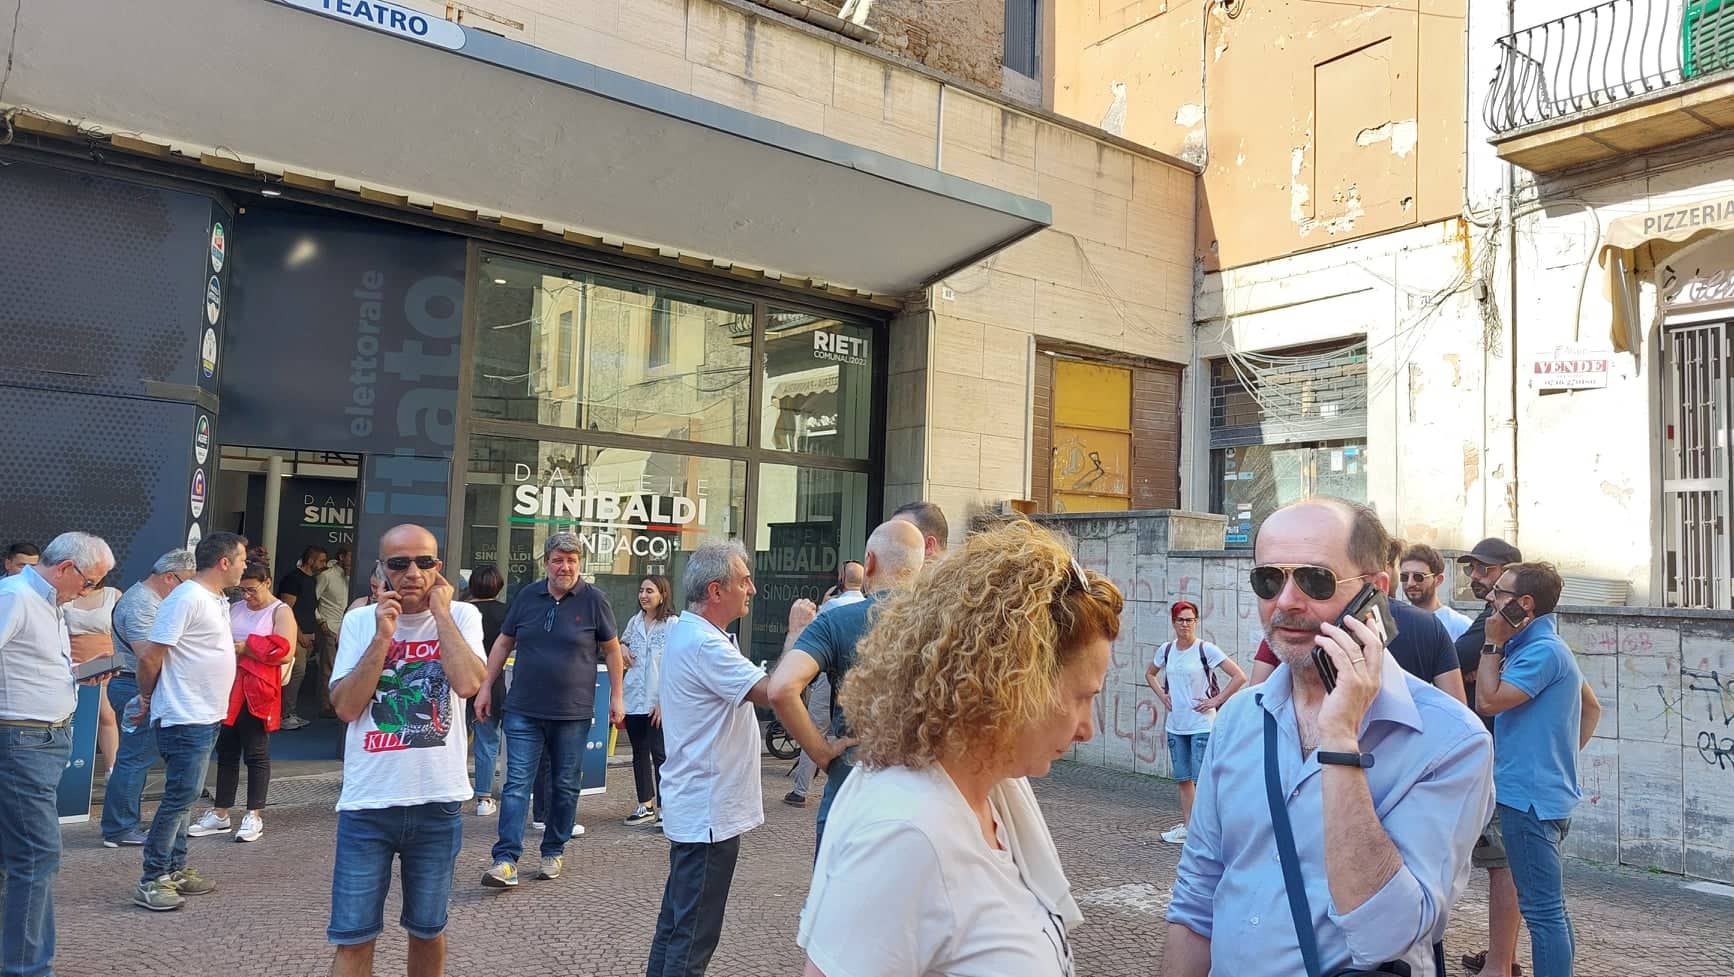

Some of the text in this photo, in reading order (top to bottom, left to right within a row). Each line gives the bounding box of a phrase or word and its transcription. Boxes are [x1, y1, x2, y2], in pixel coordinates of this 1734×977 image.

[1643, 200, 1734, 235] PIZZERIA
[345, 270, 384, 438] elettorale
[814, 331, 868, 357] RIETI
[1539, 360, 1603, 373] VENDE
[365, 275, 466, 518] itato
[514, 463, 709, 496] DANIELE
[514, 484, 707, 526] SINIBALDI
[577, 532, 669, 556] NDACO
[763, 583, 820, 600] SINDACO
[406, 643, 441, 659] LOV
[367, 730, 412, 750] KILL
